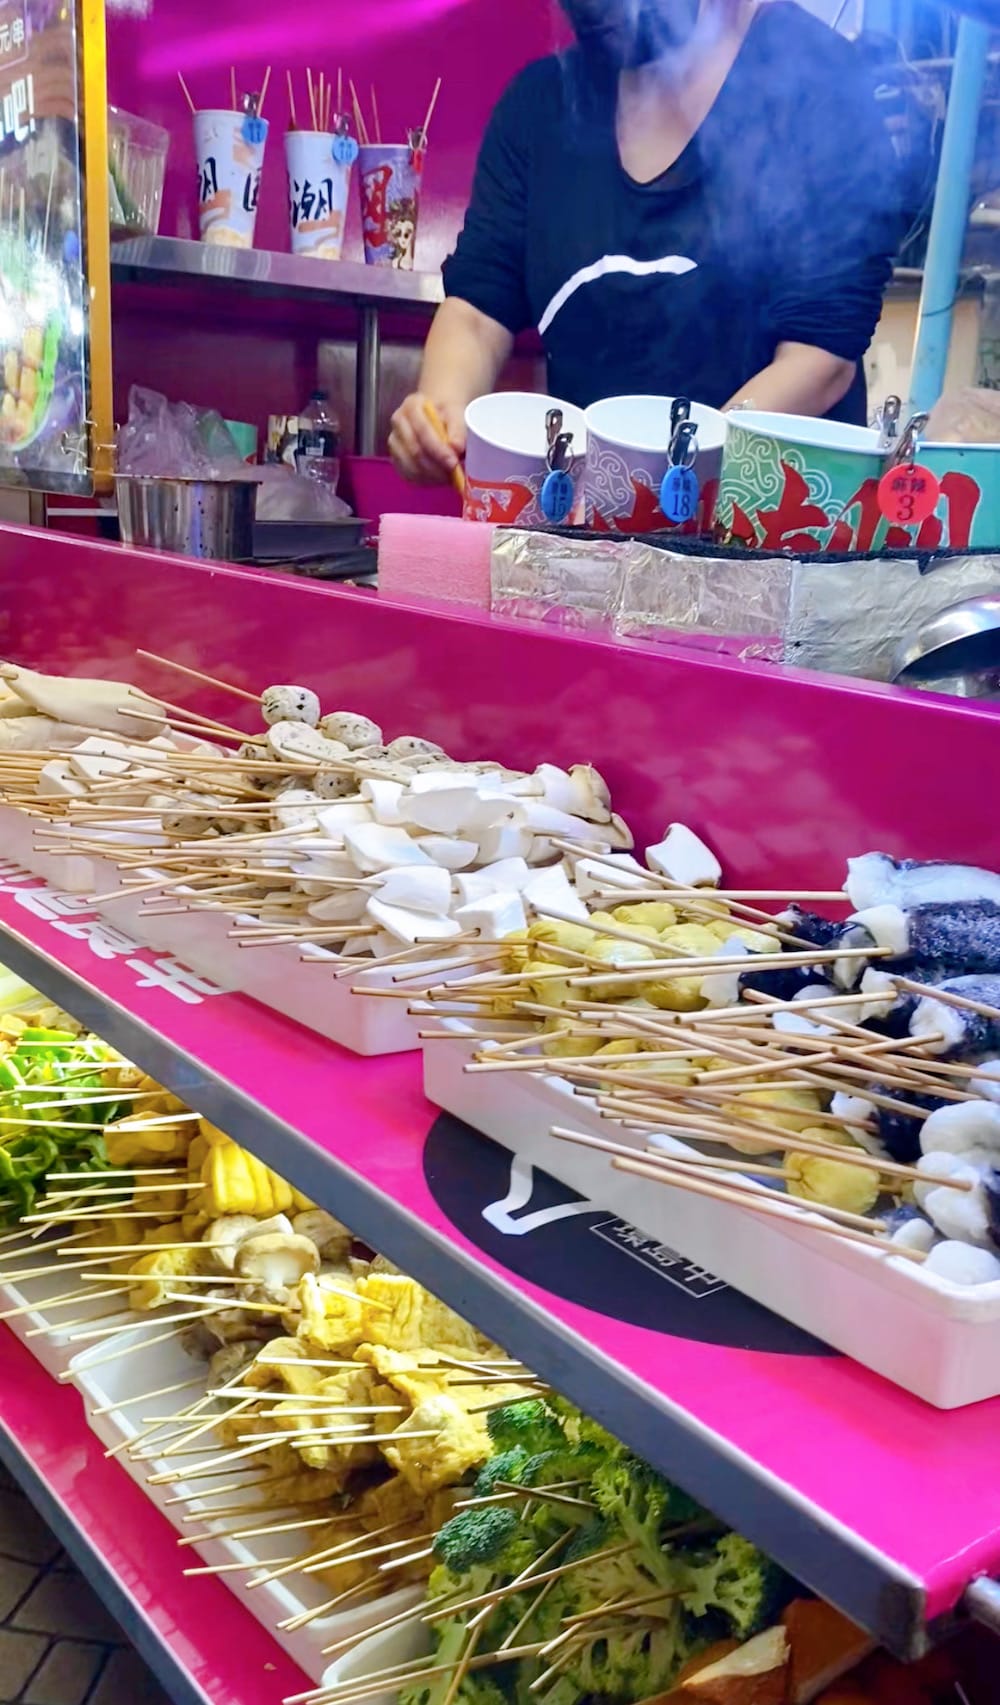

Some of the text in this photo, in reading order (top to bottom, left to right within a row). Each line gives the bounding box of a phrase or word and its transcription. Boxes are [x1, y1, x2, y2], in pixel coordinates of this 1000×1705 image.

[0, 73, 36, 143] 吧!
[291, 178, 333, 228] 潮
[671, 493, 690, 517] 18
[896, 495, 915, 521] 3
